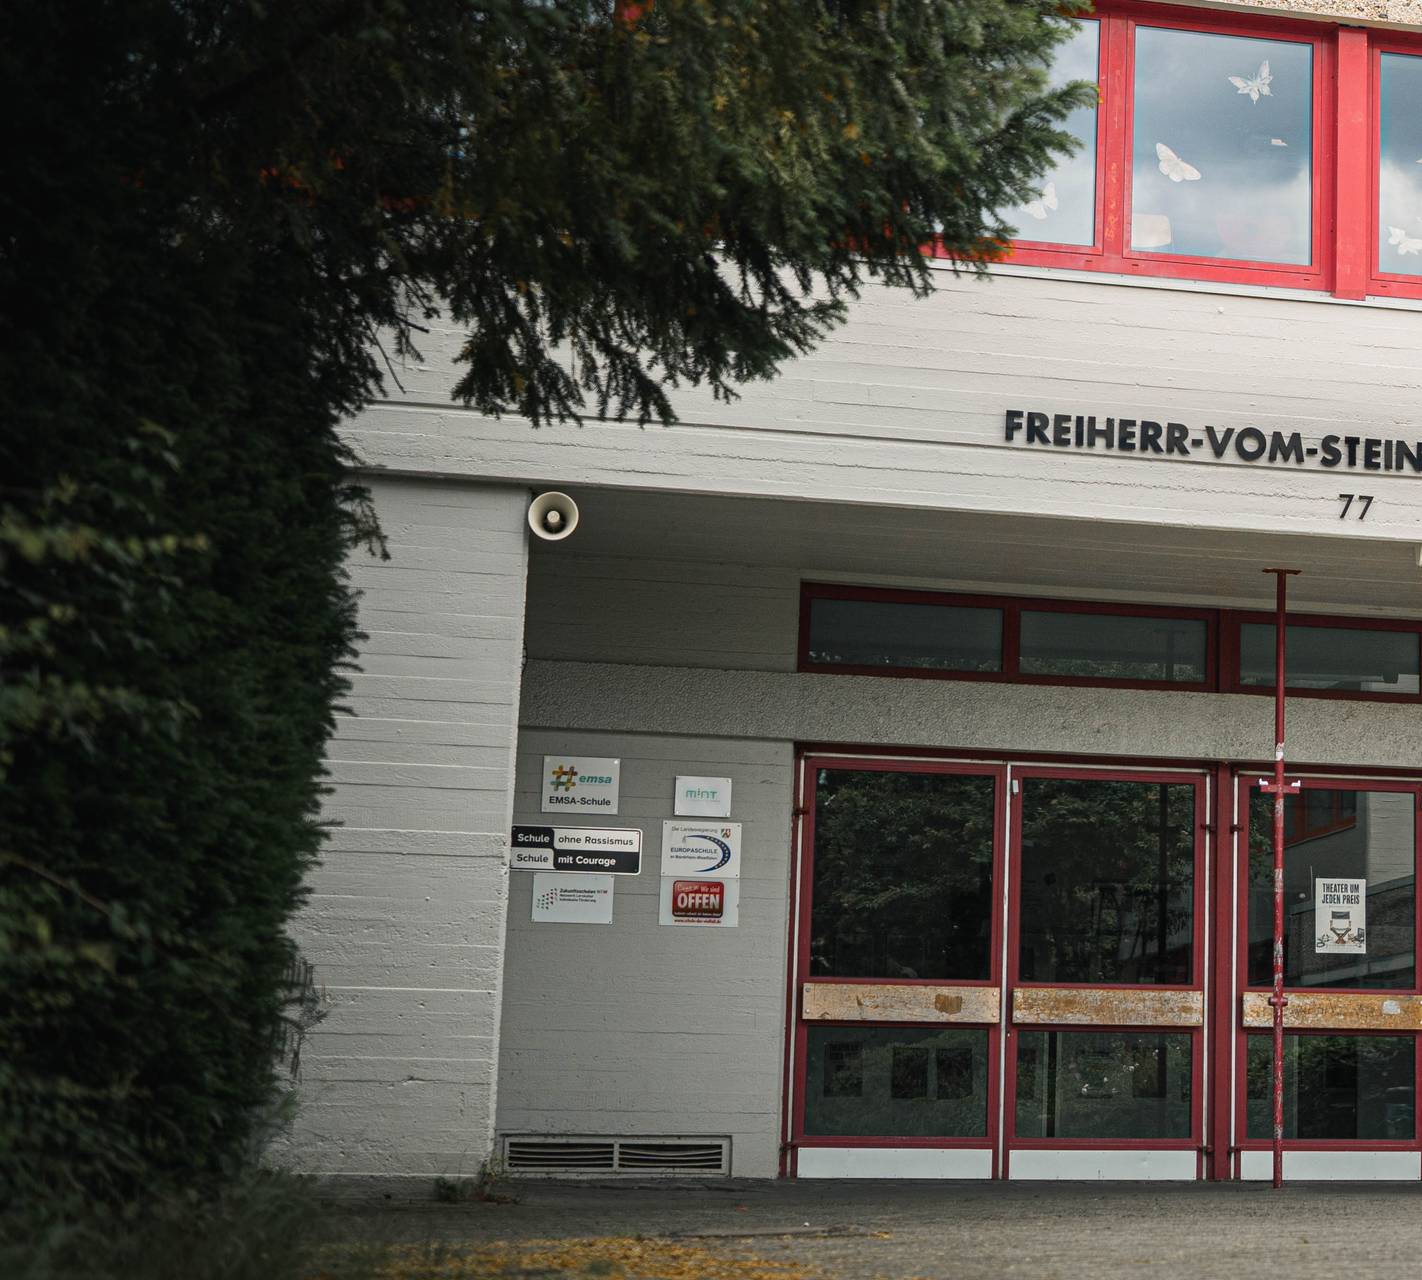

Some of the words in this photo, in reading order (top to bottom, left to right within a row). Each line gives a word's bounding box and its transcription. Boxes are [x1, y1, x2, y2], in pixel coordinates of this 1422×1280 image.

[1337, 493, 1374, 521] 77
[549, 796, 611, 806] EMSA-Schule
[517, 833, 550, 843] Schule
[558, 835, 582, 844] ohne
[584, 836, 634, 846] Rassismus
[516, 853, 549, 863] Schule
[558, 855, 573, 864] mit
[575, 855, 617, 867] Courage
[1322, 883, 1349, 893] THEATER
[1349, 884, 1360, 893] UM
[677, 892, 720, 909] OFFEN
[1321, 894, 1341, 904] JEDEN
[1342, 894, 1360, 905] PREIS
